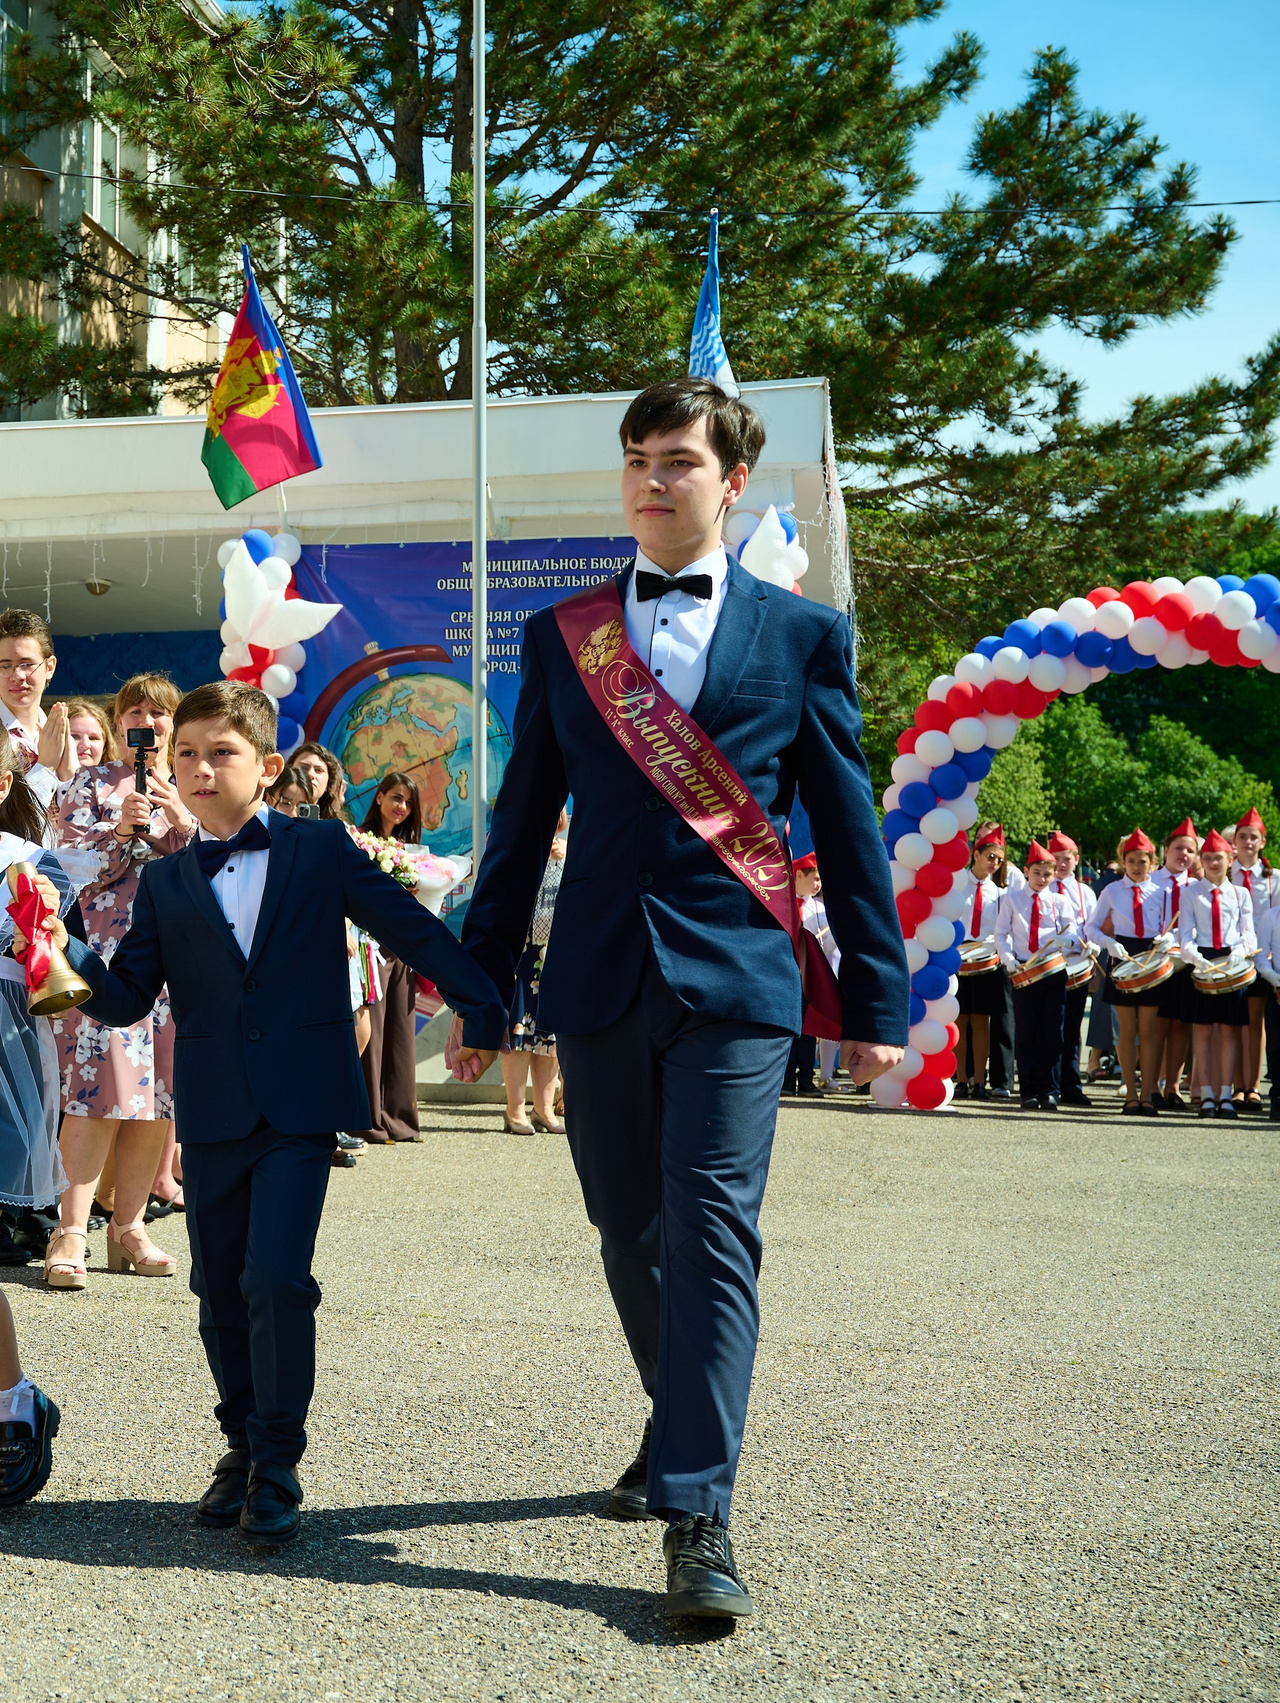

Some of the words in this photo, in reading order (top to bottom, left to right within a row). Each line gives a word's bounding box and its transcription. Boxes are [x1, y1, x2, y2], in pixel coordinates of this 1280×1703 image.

[462, 558, 587, 573] МНИЦИПАЛЬНОЕ
[437, 575, 608, 591] ОБЩБРАЗОВАТЕЛЬНОЕ
[451, 610, 512, 623] СРЕНЯЯ
[445, 627, 494, 640] ШКА
[497, 627, 520, 639] №7
[452, 644, 520, 657] МУЦИП
[601, 659, 741, 830] Выпускник
[617, 728, 634, 748] класс
[663, 708, 702, 751] Халов
[697, 749, 749, 807] Арсений
[649, 765, 668, 783] МБОУ
[661, 779, 678, 796] СОШ
